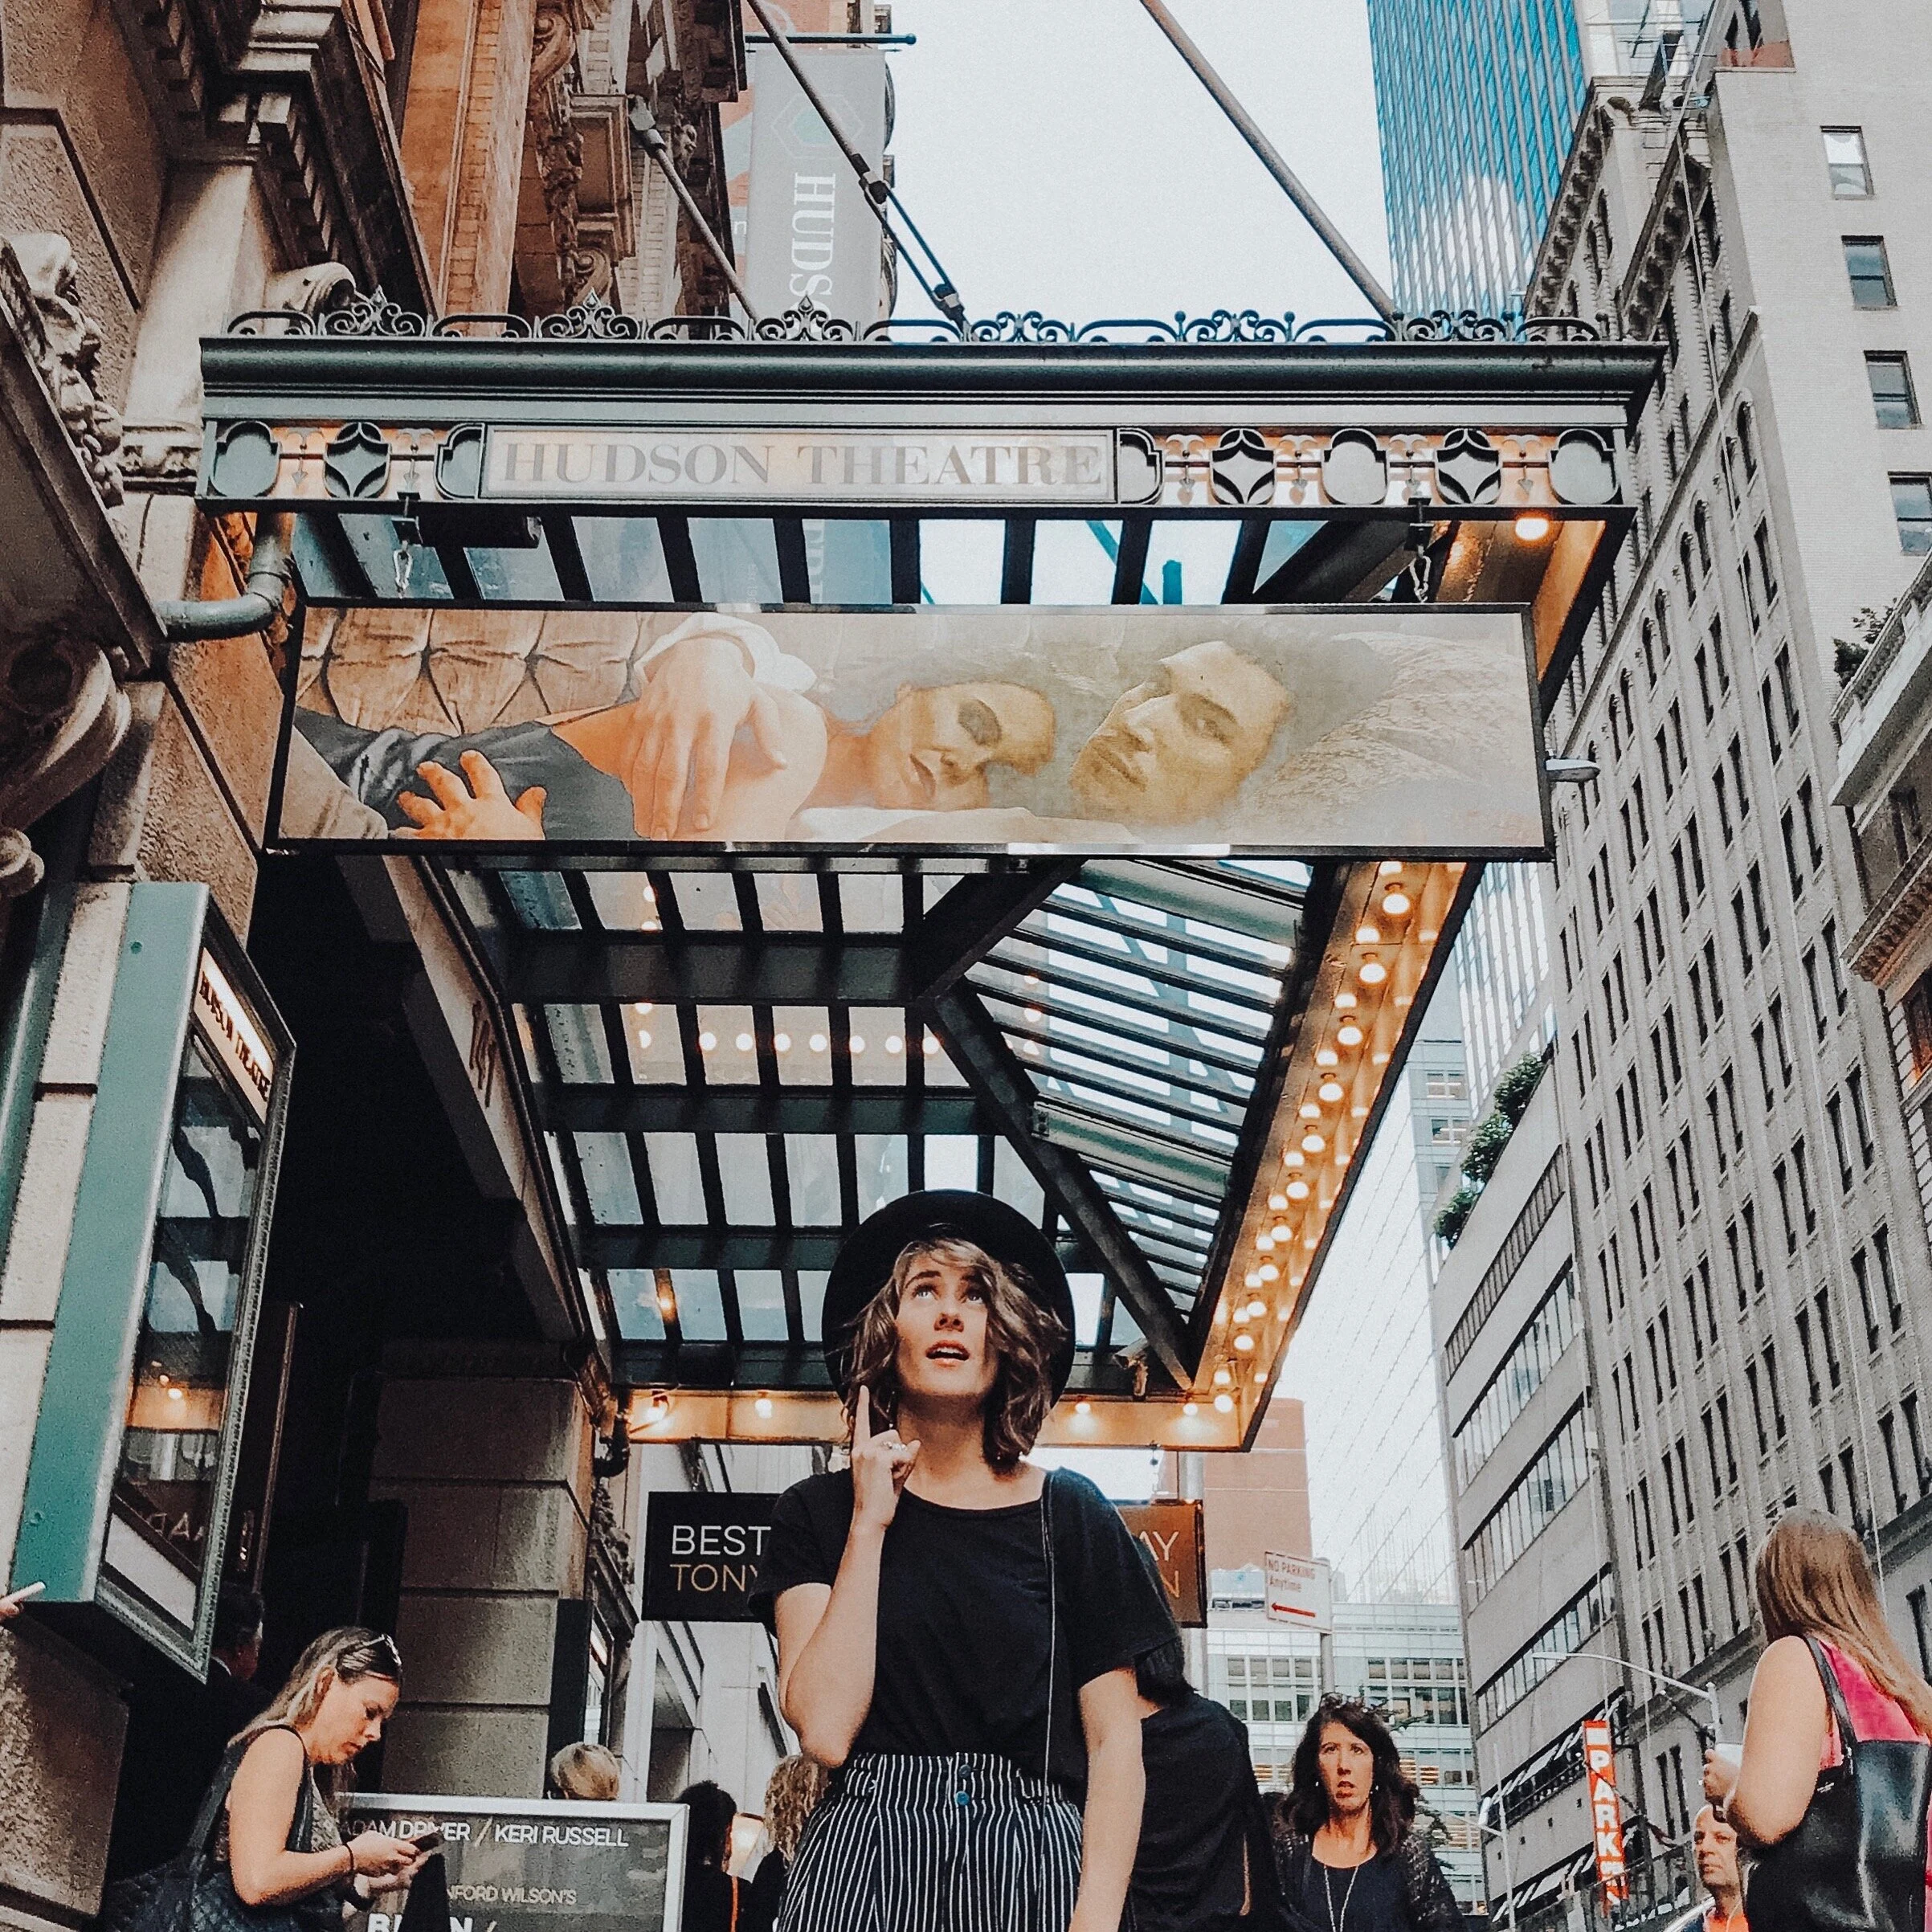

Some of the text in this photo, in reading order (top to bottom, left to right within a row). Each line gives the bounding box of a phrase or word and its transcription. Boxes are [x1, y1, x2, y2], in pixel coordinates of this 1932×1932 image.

[504, 443, 1101, 486] HUDSON THEATRE
[672, 1525, 772, 1556] BEST
[1268, 1559, 1280, 1572] NO
[495, 1824, 539, 1844] KERI
[541, 1826, 630, 1847] RUSSELL
[502, 1888, 578, 1905] WILSON'S
